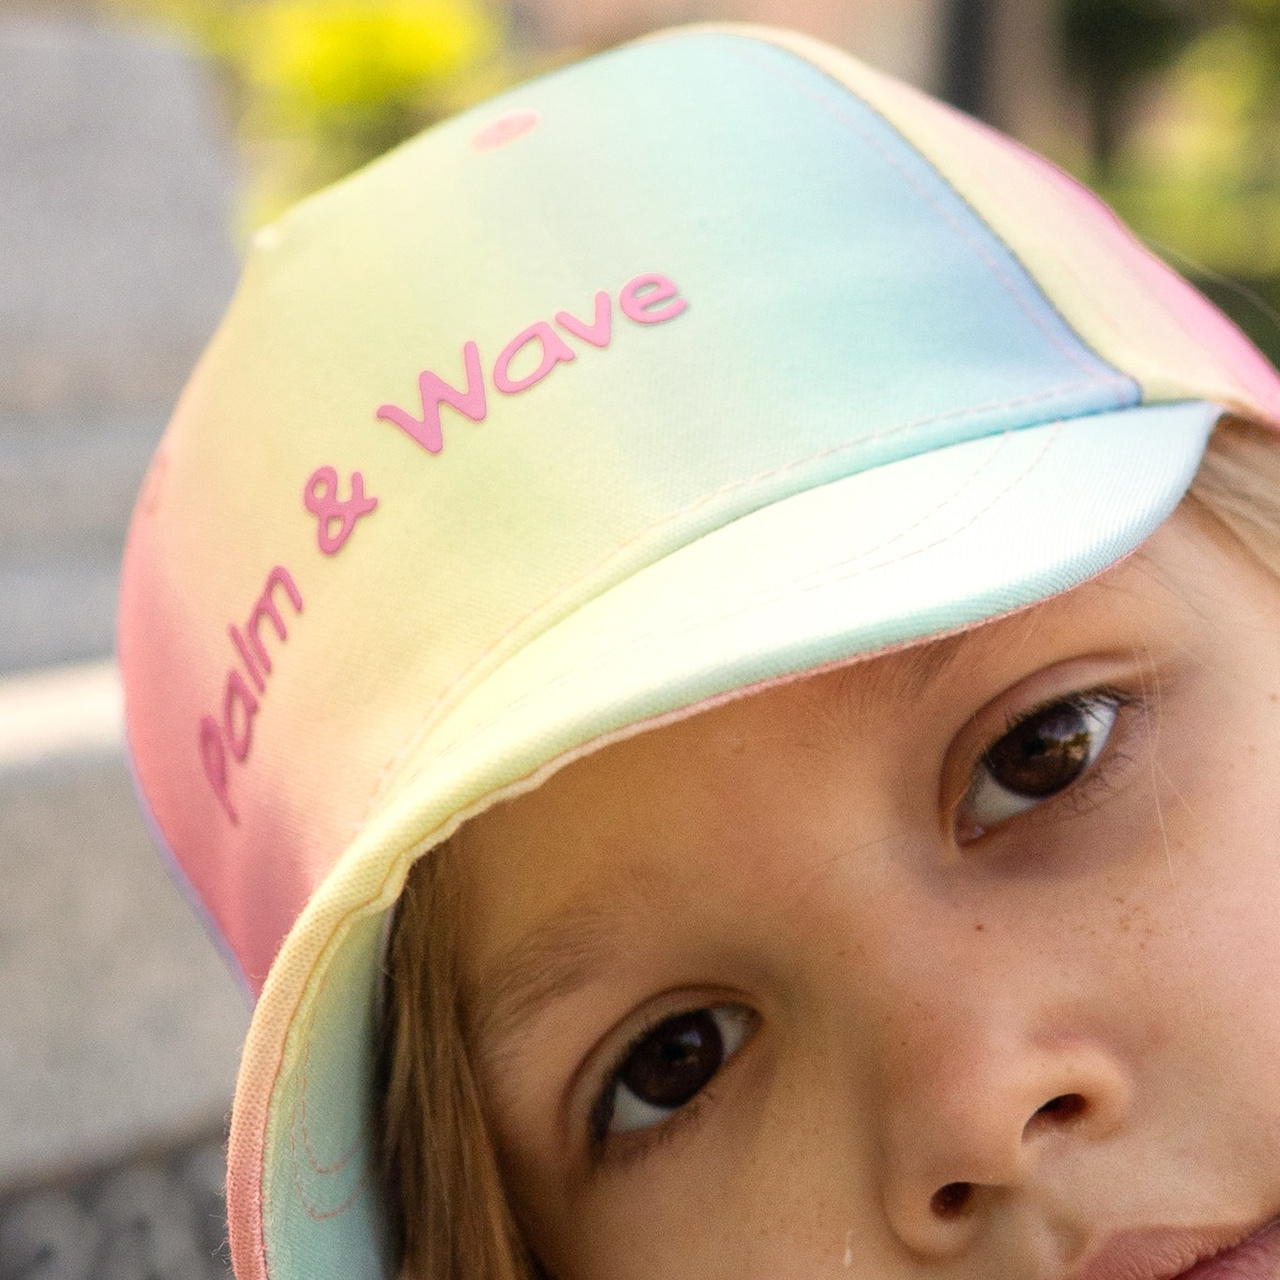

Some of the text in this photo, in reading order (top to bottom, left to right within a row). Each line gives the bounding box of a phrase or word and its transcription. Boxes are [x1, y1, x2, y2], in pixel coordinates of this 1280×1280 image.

[201, 272, 689, 827] Palm & Wave
